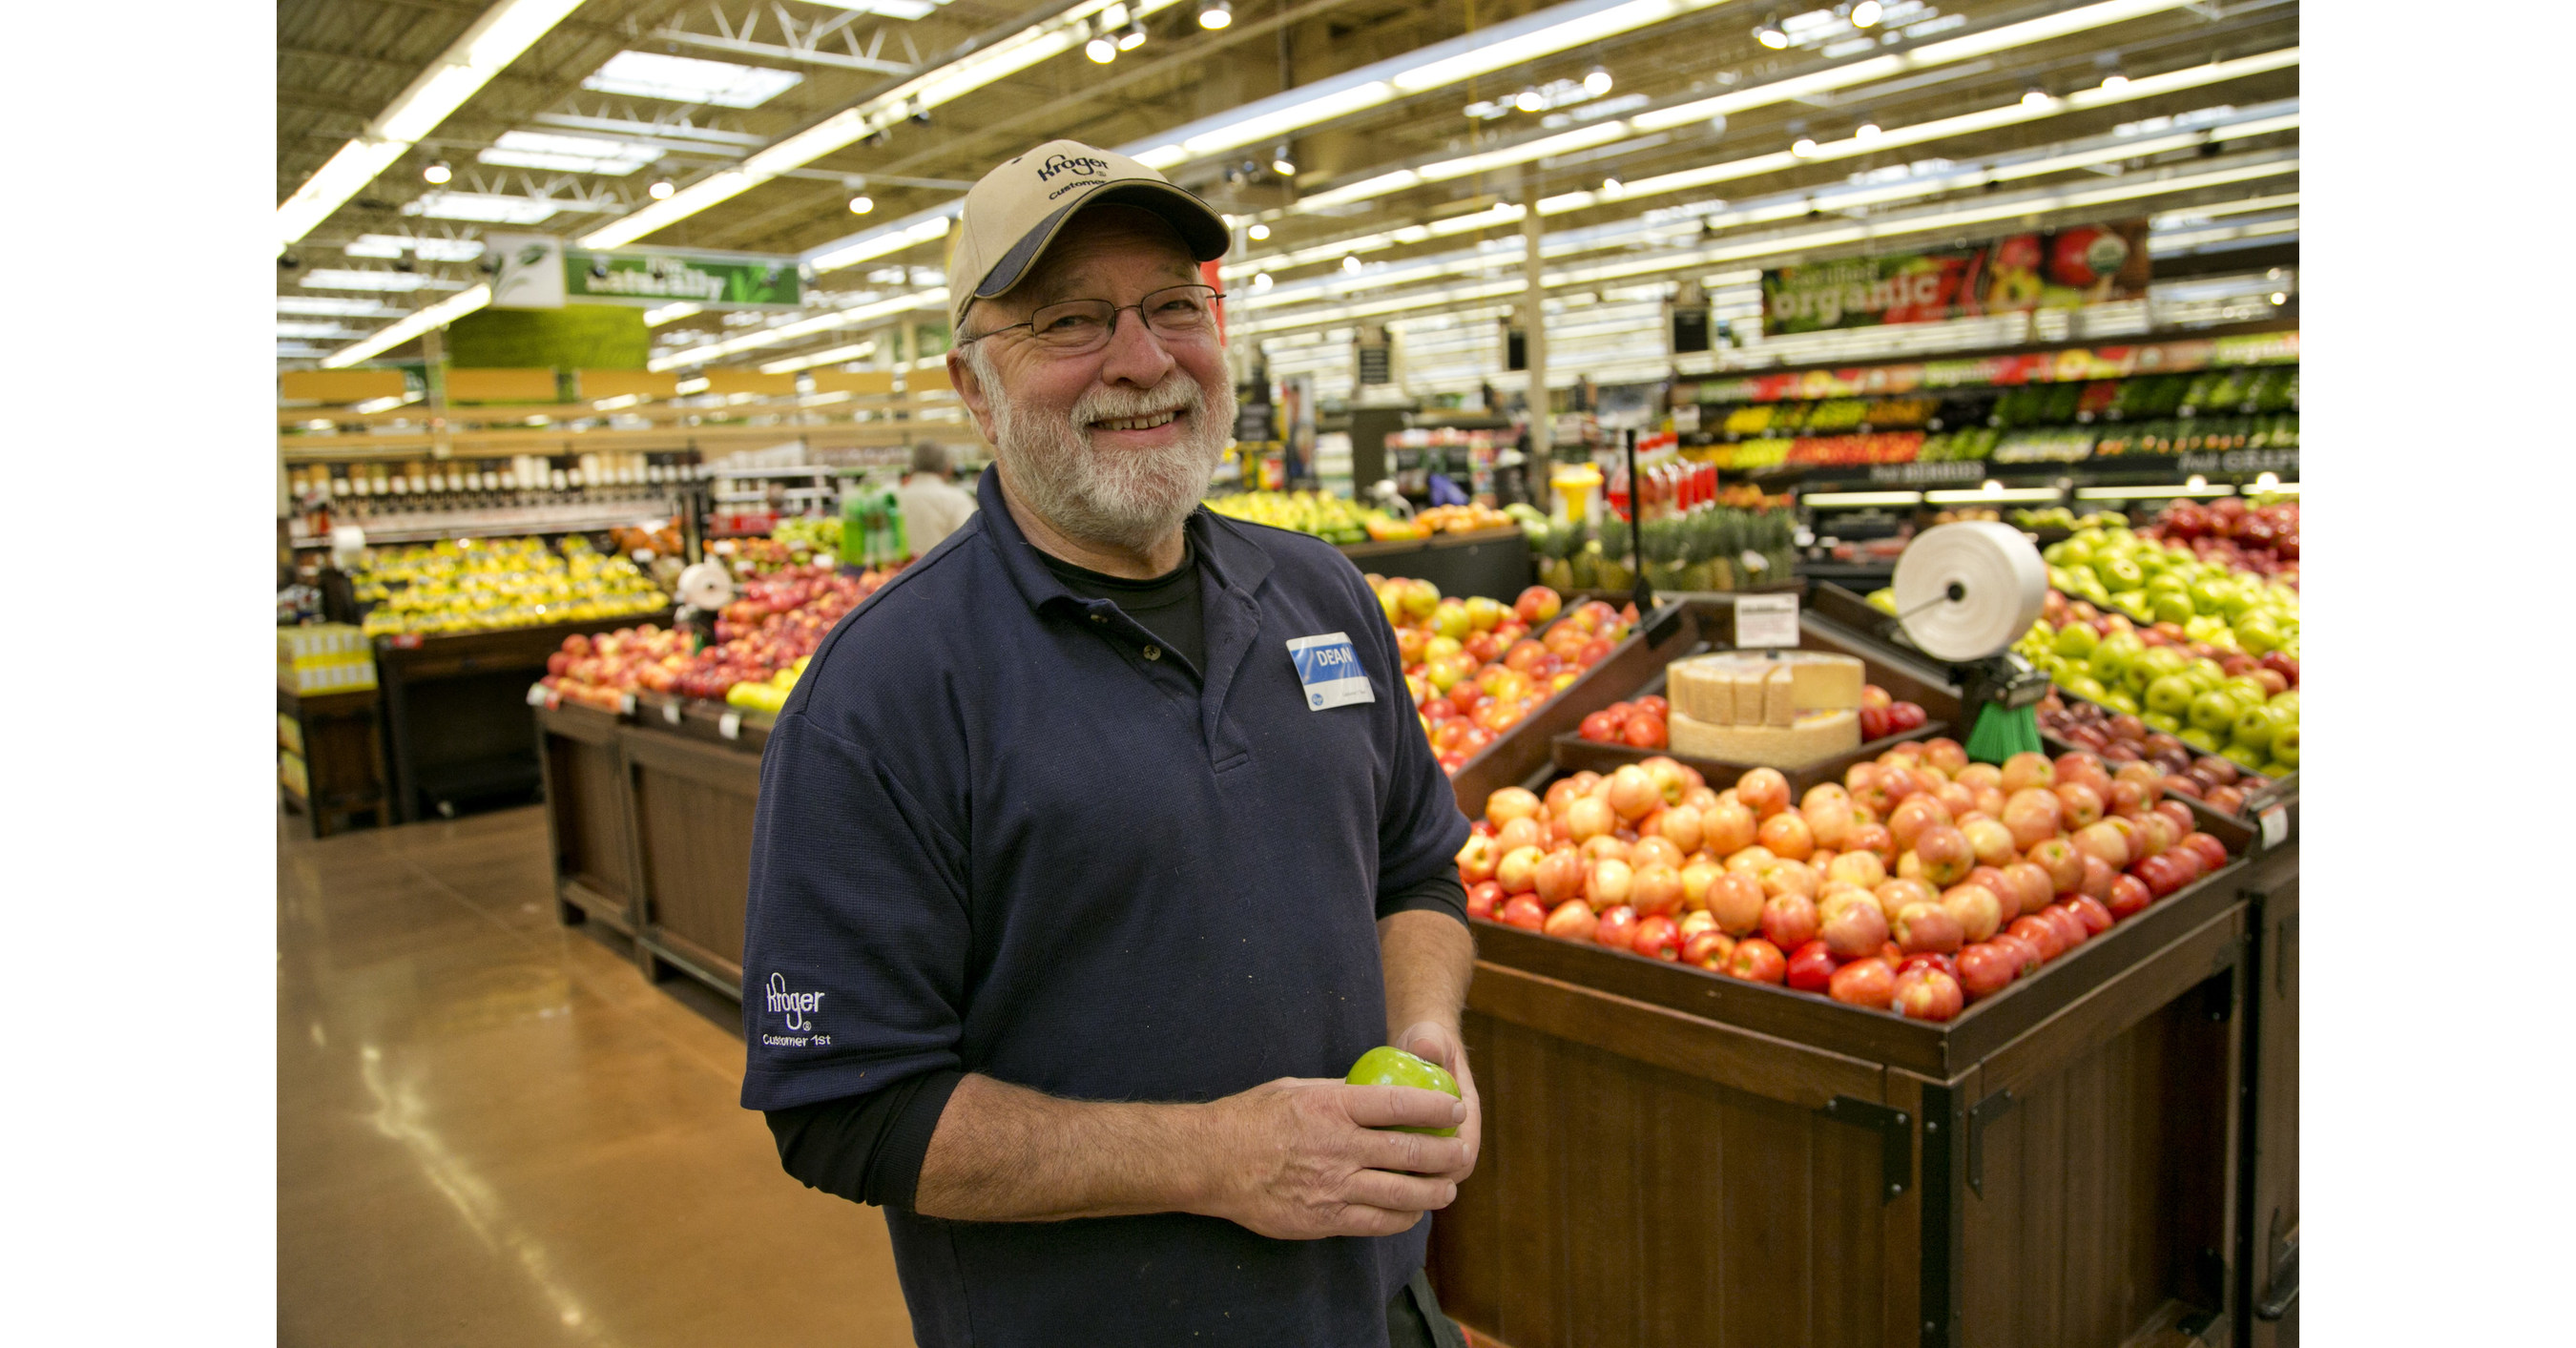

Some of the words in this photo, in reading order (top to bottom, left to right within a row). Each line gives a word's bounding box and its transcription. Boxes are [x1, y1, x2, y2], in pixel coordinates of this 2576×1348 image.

[1774, 271, 1940, 326] organic
[1316, 647, 1353, 667] DEAN
[766, 972, 825, 1030] Kroger
[762, 1033, 808, 1047] Customer
[810, 1034, 831, 1047] 1st
